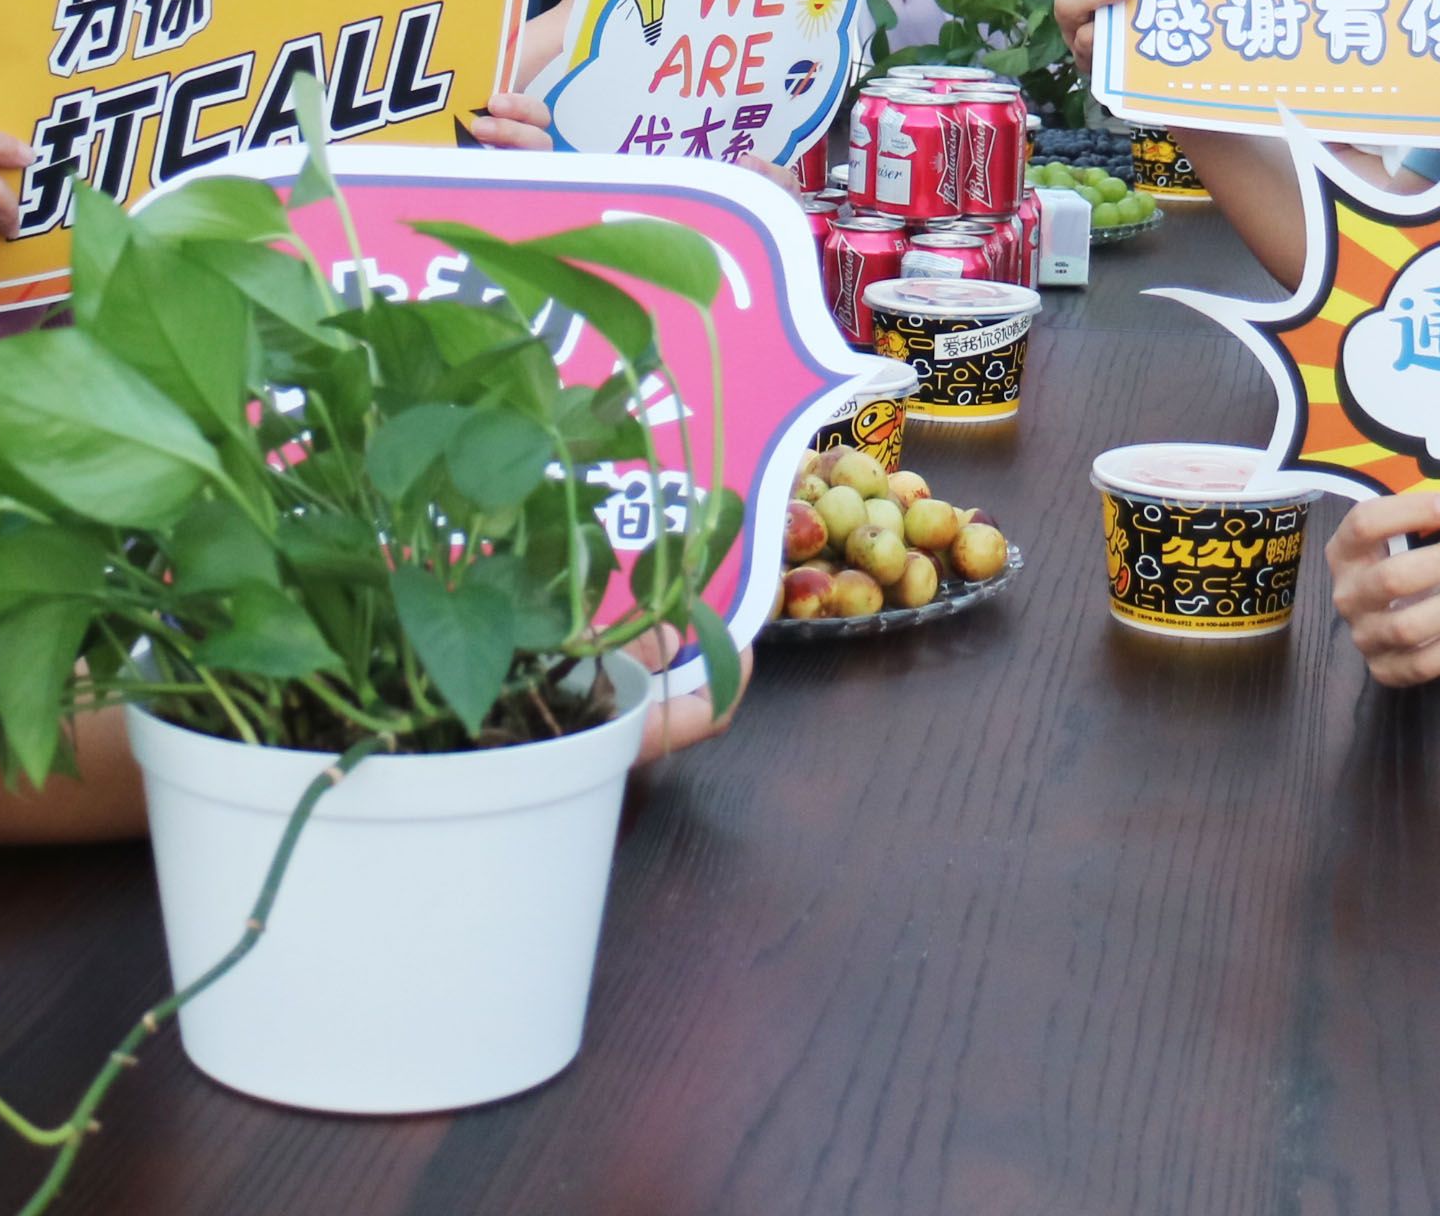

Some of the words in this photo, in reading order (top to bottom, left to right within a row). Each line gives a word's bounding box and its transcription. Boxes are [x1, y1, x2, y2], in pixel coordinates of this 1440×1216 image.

[648, 31, 774, 99] ARE
[616, 103, 774, 164] 伐木累
[943, 121, 958, 205] Budweiser
[968, 119, 986, 201] Budweiser
[838, 247, 854, 327] Budweiser
